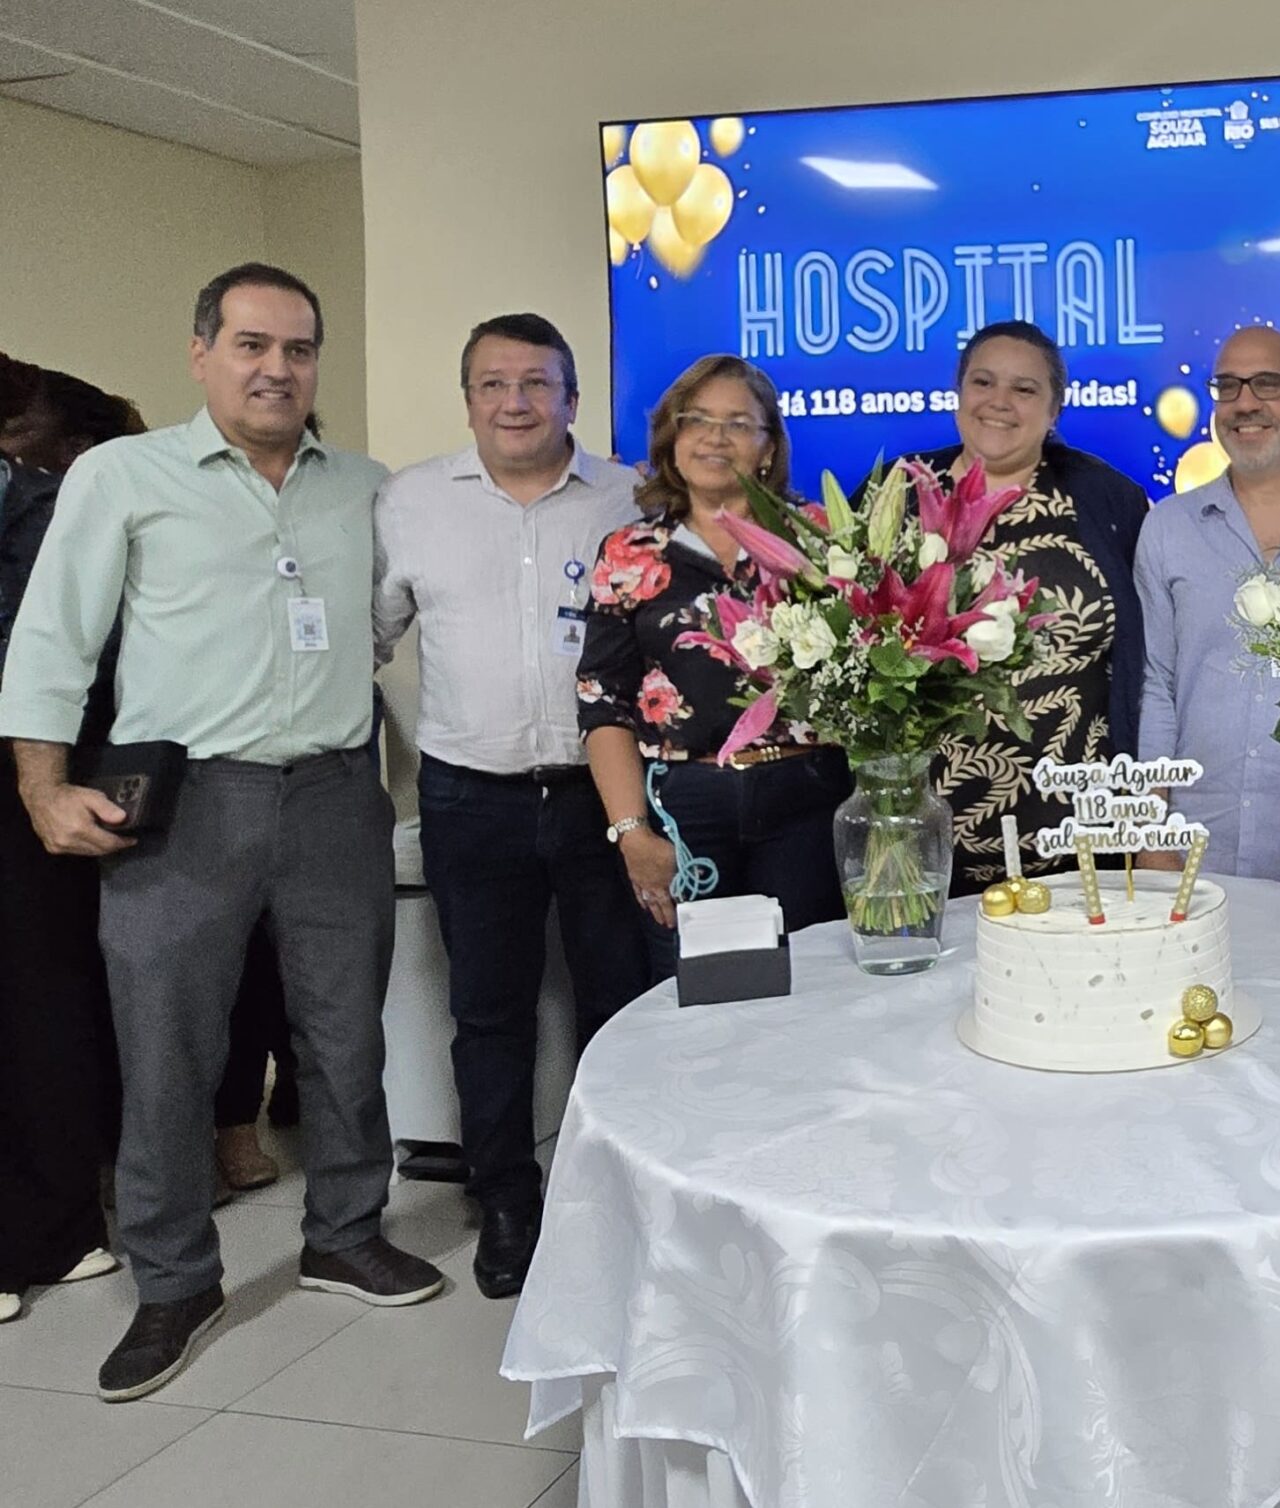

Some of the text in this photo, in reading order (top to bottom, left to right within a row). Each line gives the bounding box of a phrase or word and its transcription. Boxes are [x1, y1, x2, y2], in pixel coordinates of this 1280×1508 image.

[1147, 132, 1207, 149] AGUIAR
[1150, 118, 1204, 135] SOUZA
[738, 238, 1164, 358] HOSPITAL
[809, 388, 856, 416] 118
[861, 390, 926, 414] anos
[1040, 760, 1197, 793] Souza Aguiar
[1076, 795, 1158, 821] 118 anos
[1041, 821, 1140, 853] salando
